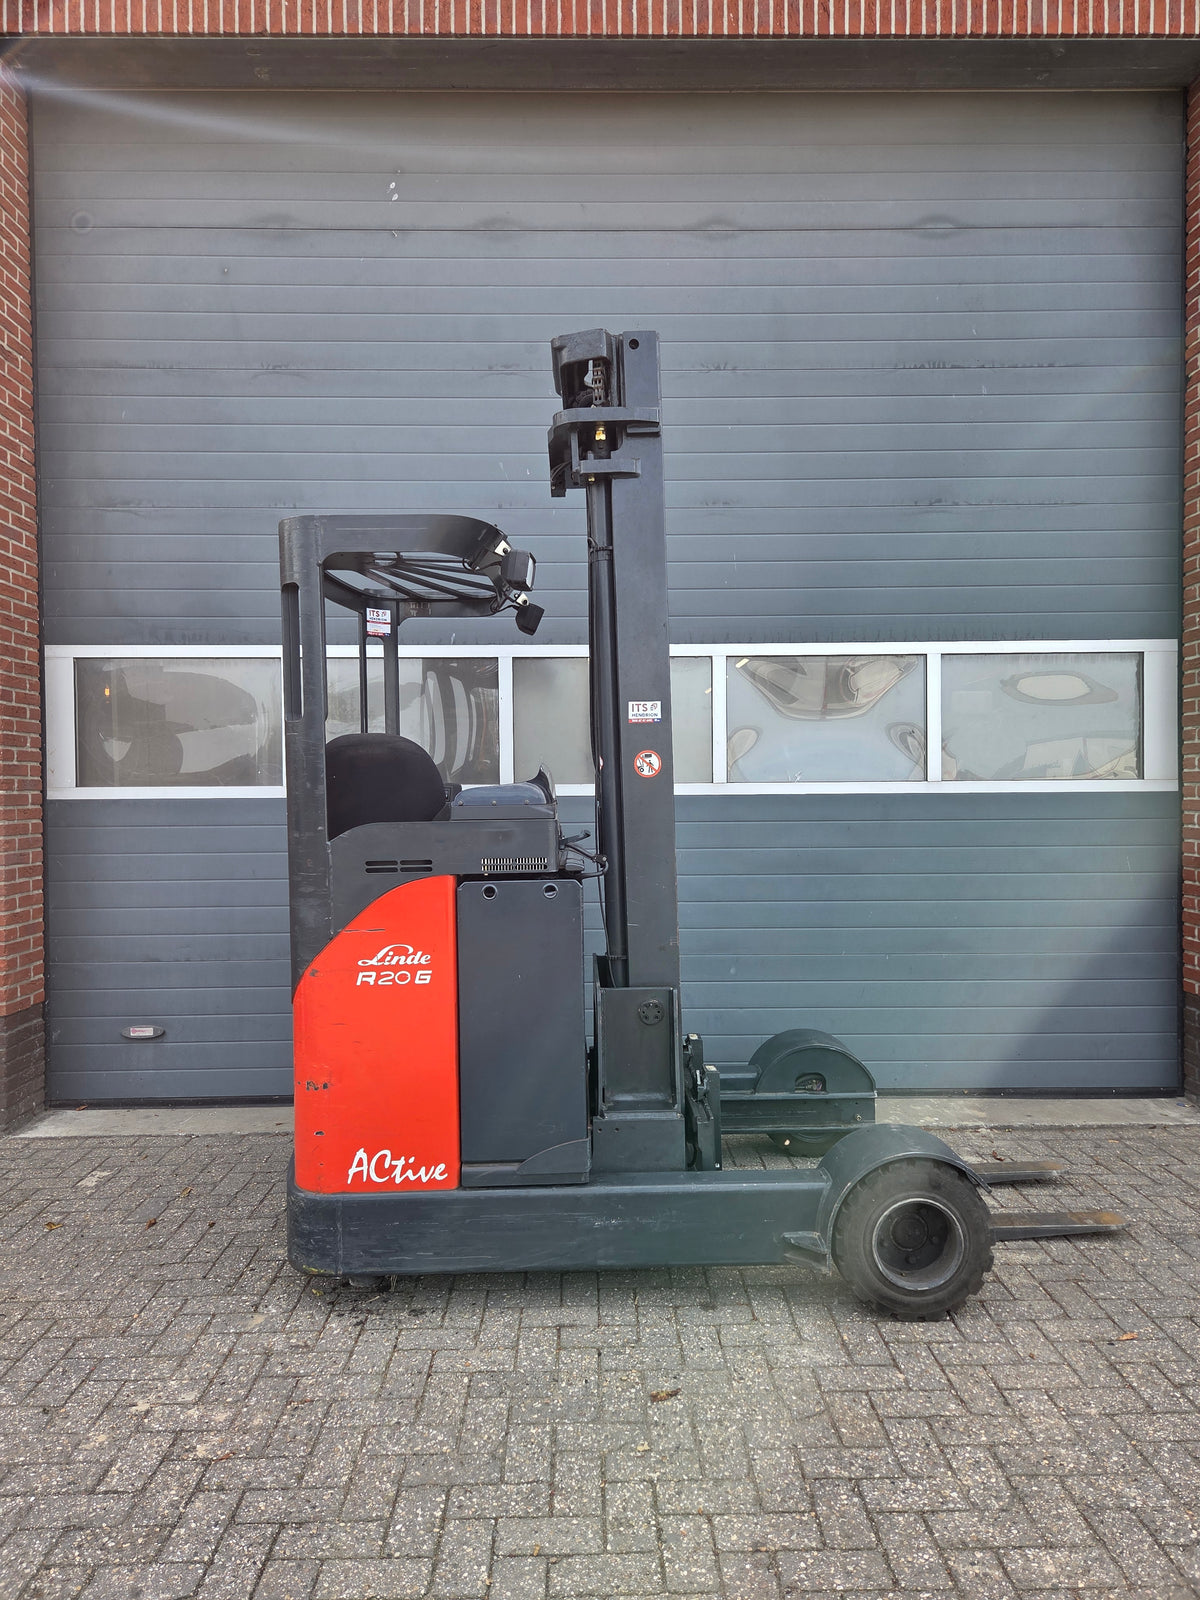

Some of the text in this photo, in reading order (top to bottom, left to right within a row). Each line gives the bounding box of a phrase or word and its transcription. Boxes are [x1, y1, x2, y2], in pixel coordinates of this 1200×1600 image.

[631, 703, 648, 712] ITS
[357, 944, 431, 966] Linde
[347, 1147, 448, 1184] ACtive
